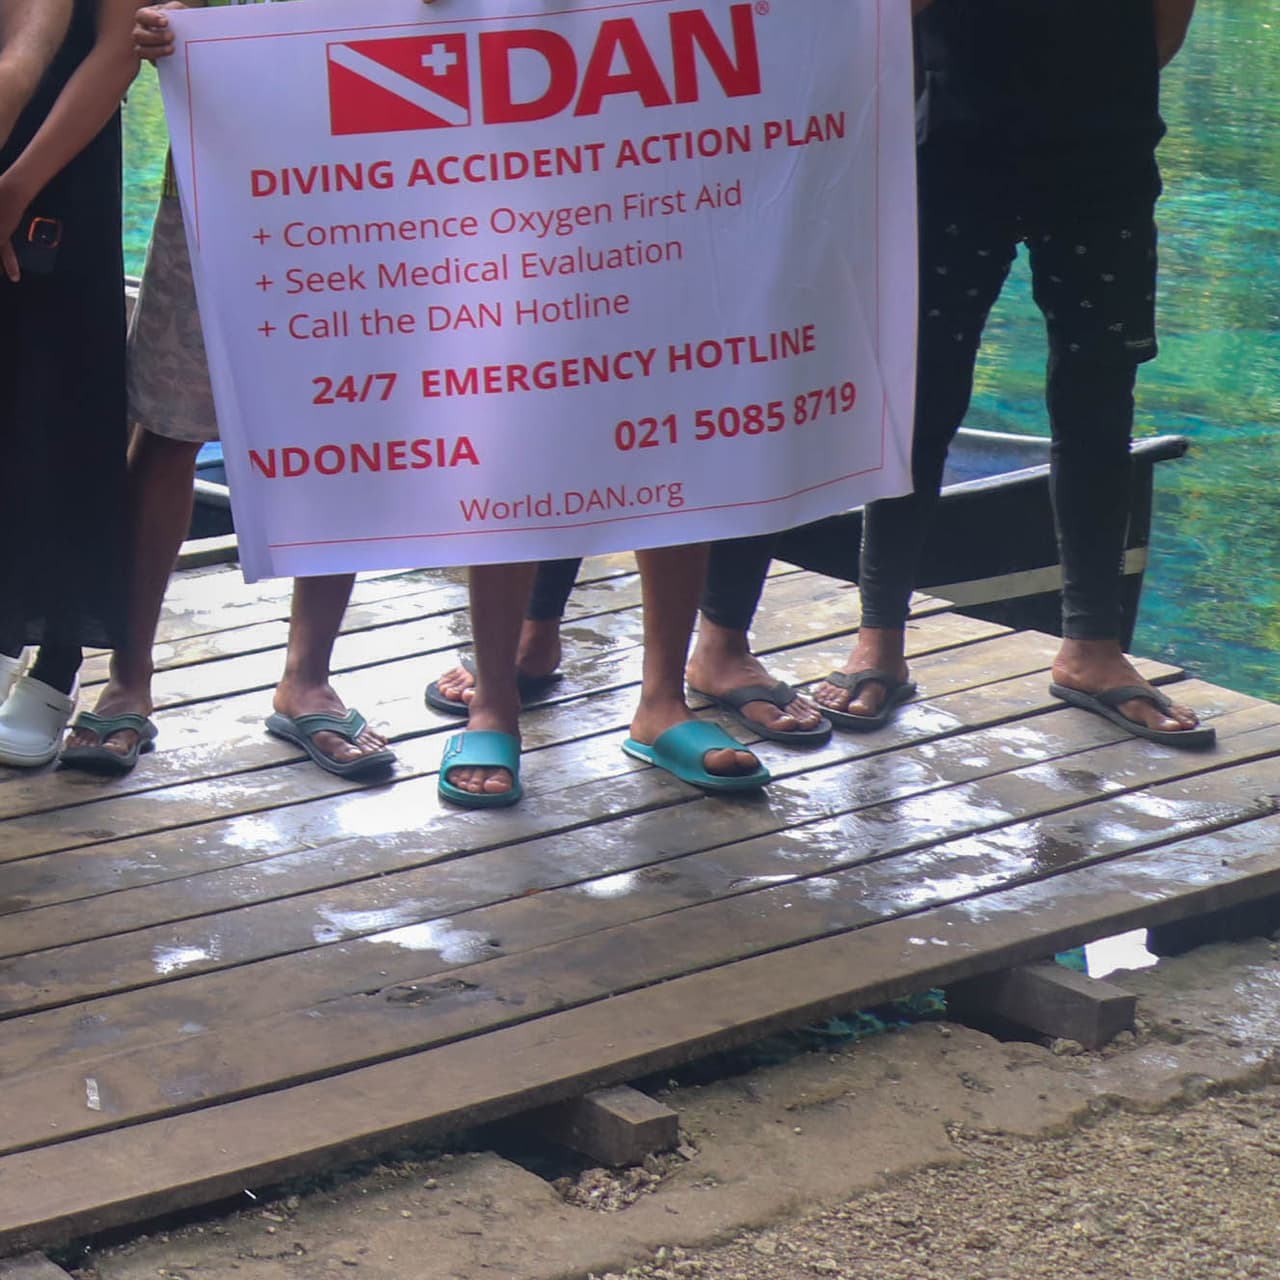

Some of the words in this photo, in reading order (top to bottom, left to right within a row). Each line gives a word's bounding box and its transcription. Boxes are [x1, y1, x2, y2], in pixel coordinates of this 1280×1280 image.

[479, 3, 764, 127] DAN
[251, 158, 396, 199] DIVING
[408, 142, 607, 189] ACCIDENT
[617, 125, 753, 169] ACTION
[764, 110, 846, 150] PLAN
[283, 214, 479, 249] Commence
[489, 203, 613, 245] Oxygen
[622, 187, 687, 220] First
[696, 179, 744, 211] Aid
[286, 262, 367, 296] Seek
[379, 251, 510, 289] Medical
[521, 236, 685, 280] Evaluation
[287, 310, 349, 340] Call
[361, 308, 417, 337] the
[428, 302, 504, 333] DAN
[515, 291, 631, 326] Hotline
[312, 371, 399, 407] 24/7
[421, 349, 657, 400] EMERGENCY
[669, 324, 817, 374] HOTLINE
[249, 435, 481, 481] NDONESIA
[614, 414, 679, 453] 021
[696, 400, 786, 442] 5085
[793, 380, 858, 428] 8719
[459, 479, 686, 524] World.DAN.org
